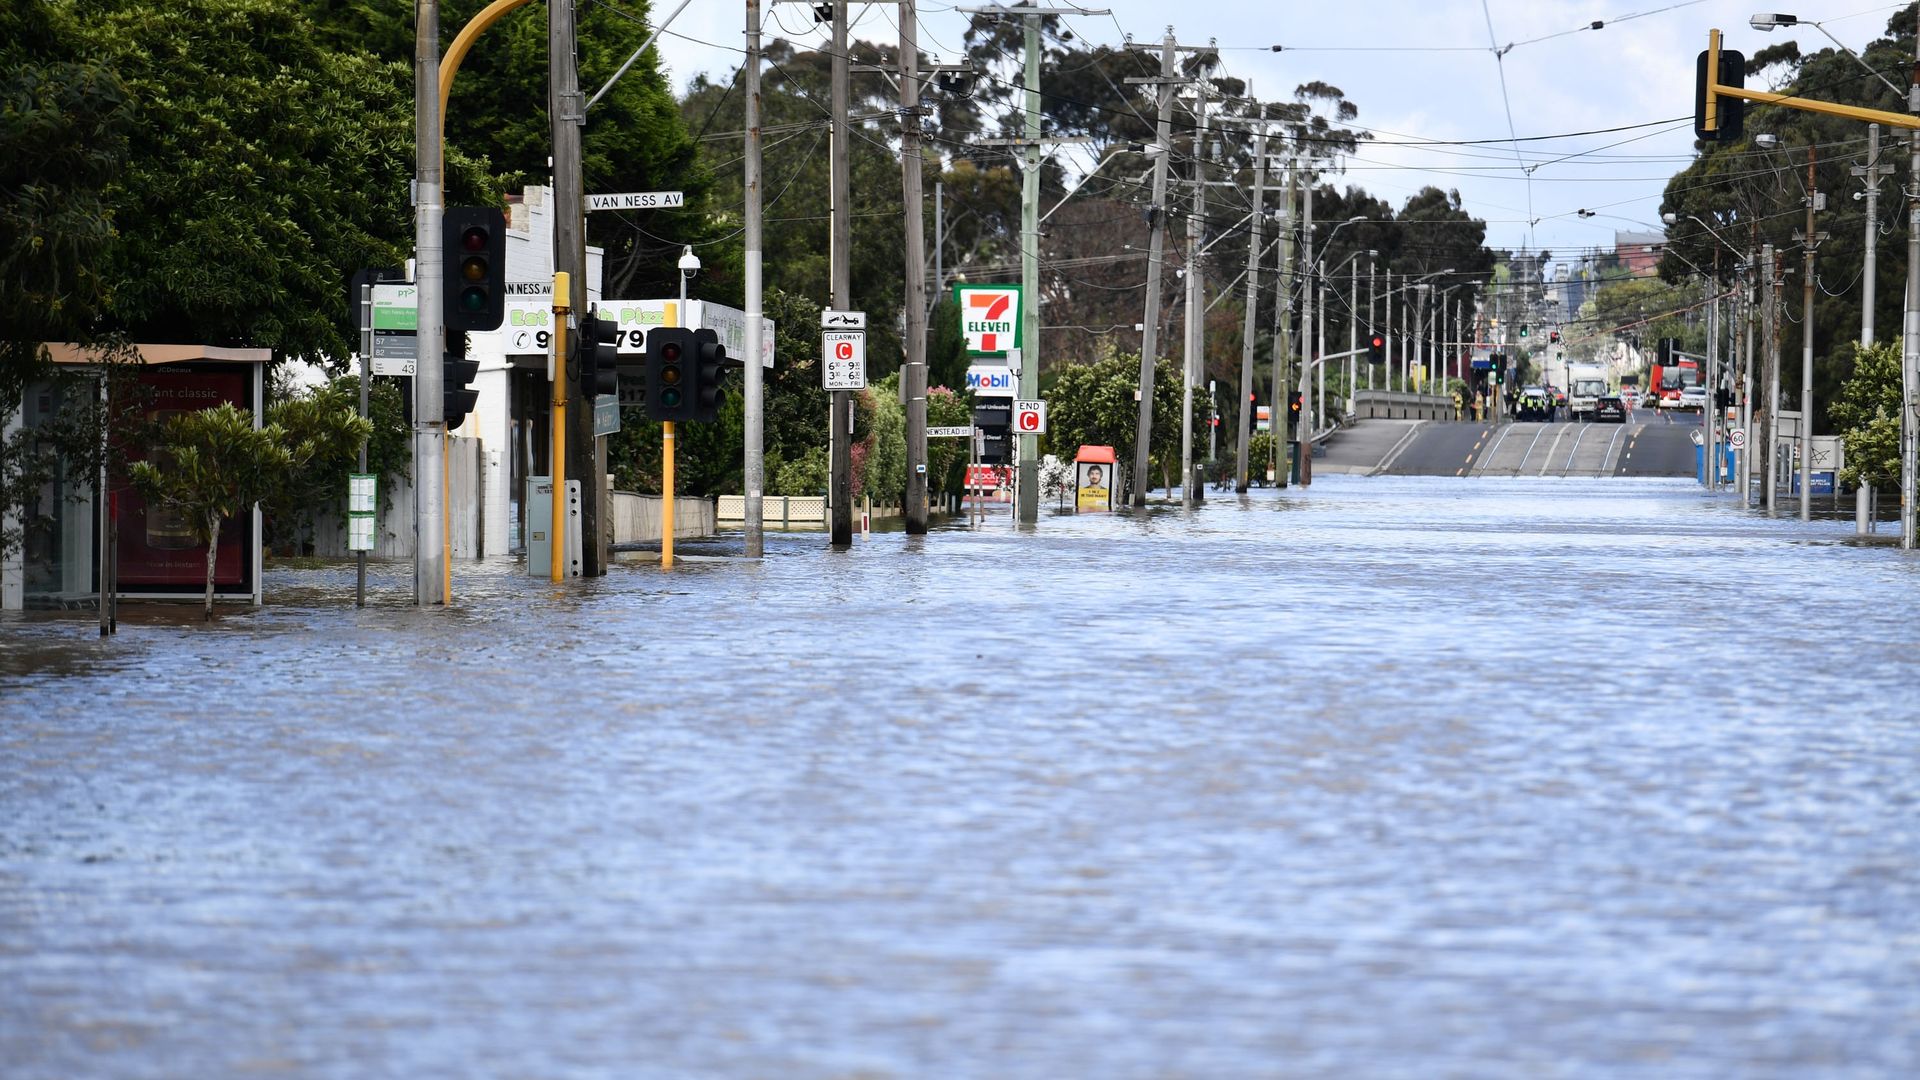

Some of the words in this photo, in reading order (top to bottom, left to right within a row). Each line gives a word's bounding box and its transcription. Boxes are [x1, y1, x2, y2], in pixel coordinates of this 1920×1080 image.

[593, 197, 619, 208] VAN
[625, 195, 656, 207] NESS
[664, 194, 681, 205] AV
[504, 284, 515, 295] AN
[517, 284, 540, 295] NESS
[510, 309, 549, 327] Eat
[621, 307, 665, 326] Pizz
[375, 337, 385, 345] 57
[401, 364, 415, 374] 43
[967, 372, 1009, 388] Mobil
[177, 386, 218, 398] classic
[1019, 402, 1040, 410] END
[927, 428, 960, 436] NEWSTEAD
